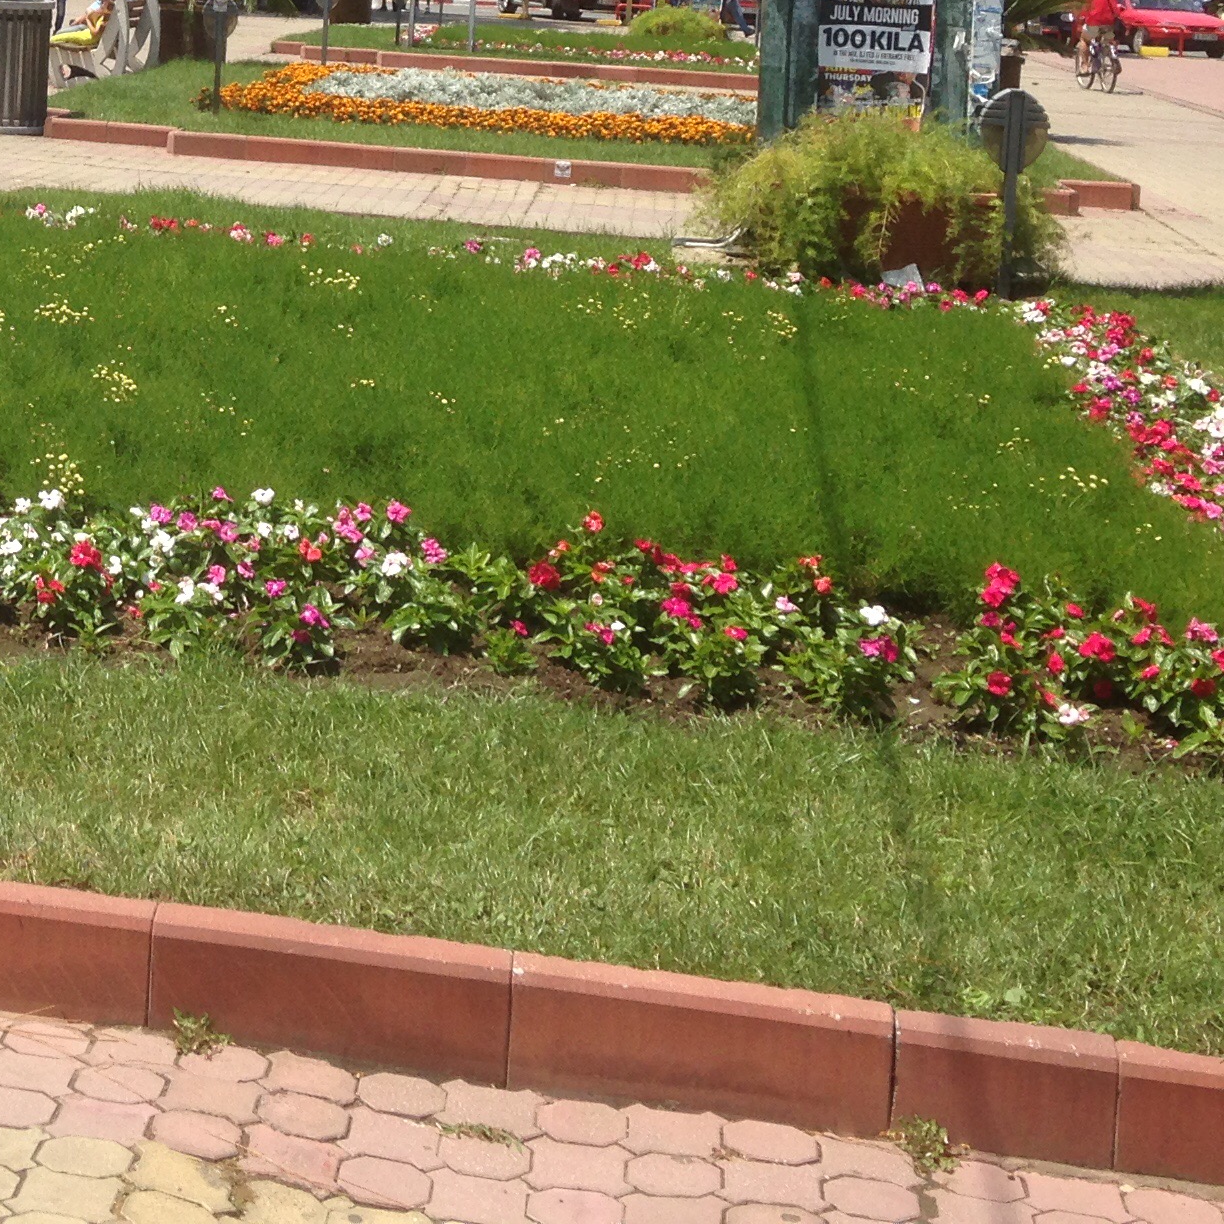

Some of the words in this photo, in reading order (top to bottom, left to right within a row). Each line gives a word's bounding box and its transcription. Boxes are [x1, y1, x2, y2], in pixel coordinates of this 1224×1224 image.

[829, 4, 861, 22] JULY
[863, 6, 920, 25] MORNING
[822, 26, 867, 49] 100
[869, 30, 925, 53] KILA
[824, 73, 873, 82] THURSDAY
